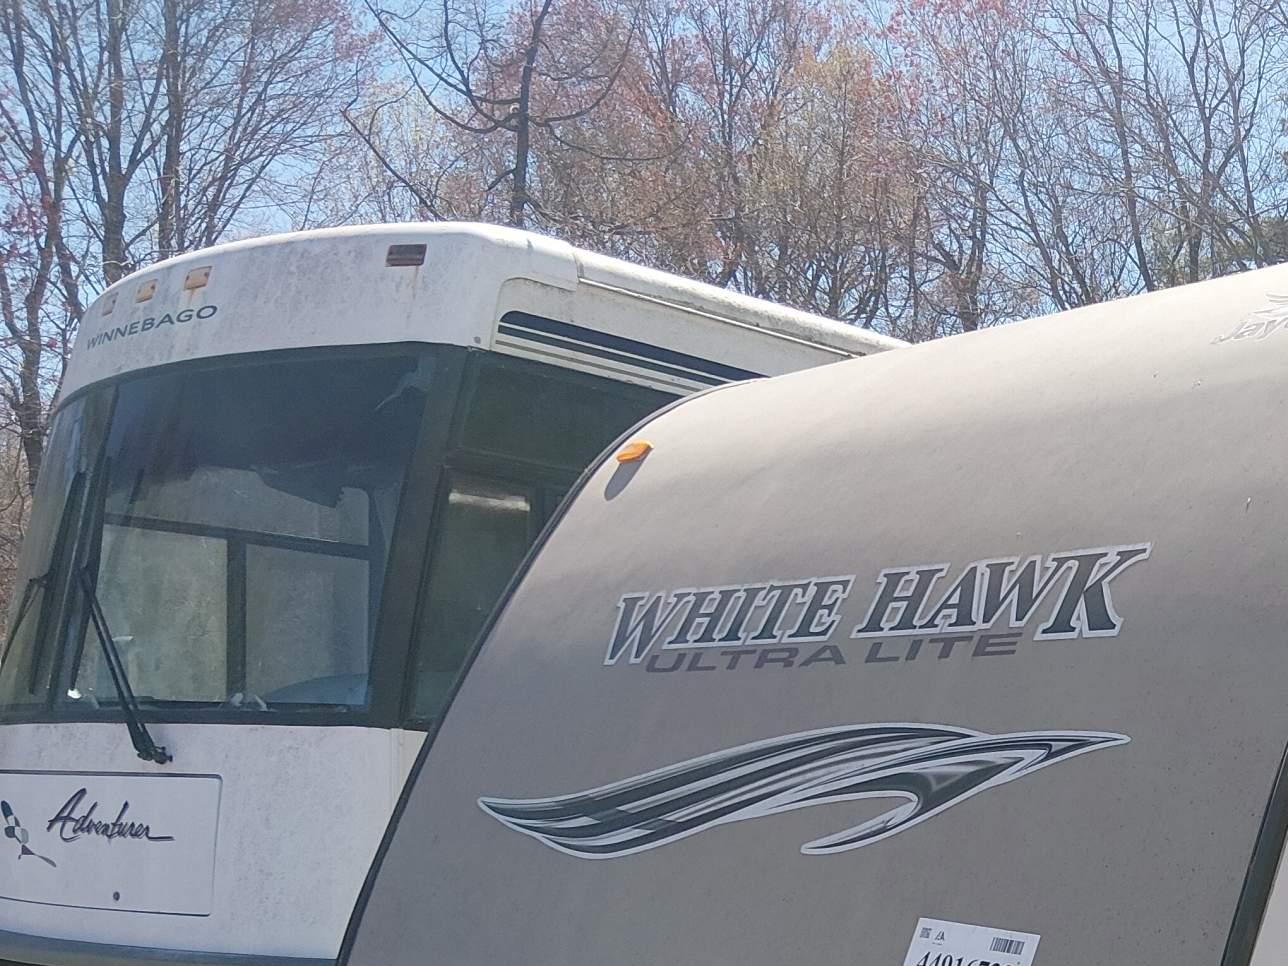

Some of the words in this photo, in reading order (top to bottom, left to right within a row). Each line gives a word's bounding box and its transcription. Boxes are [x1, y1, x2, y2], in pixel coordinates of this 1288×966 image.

[87, 305, 218, 350] WINNEBAGO
[604, 574, 856, 667] WHITE
[850, 541, 1154, 641] HAWK
[645, 643, 848, 674] ULTRA
[864, 632, 1024, 664] LITE
[46, 788, 175, 843] Adventurer
